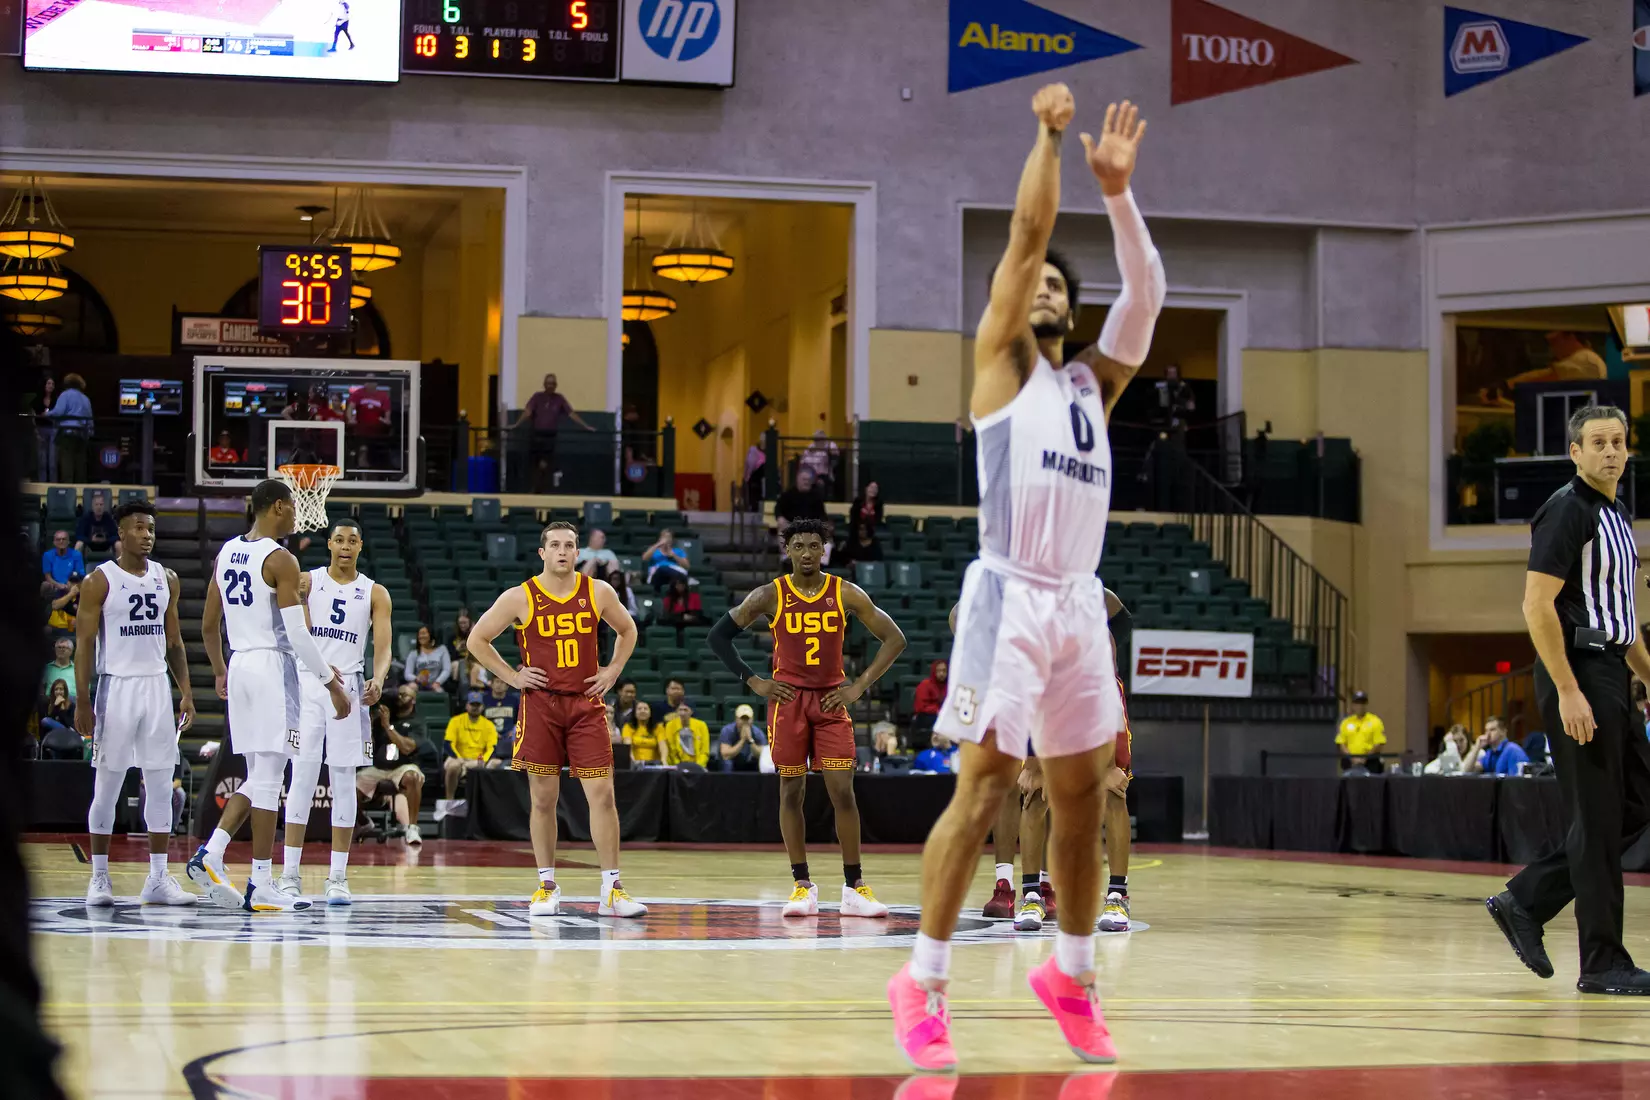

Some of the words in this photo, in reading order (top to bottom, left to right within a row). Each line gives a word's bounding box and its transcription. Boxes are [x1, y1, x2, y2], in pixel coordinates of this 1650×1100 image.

[443, 0, 460, 23] 6
[570, 1, 588, 29] 5
[413, 24, 441, 35] FOULS
[484, 28, 516, 38] PLAYER
[518, 29, 540, 39] FOUL
[581, 32, 609, 42] FOULS
[958, 22, 1075, 54] Alamo
[415, 34, 437, 57] 10
[455, 35, 469, 58] 3
[492, 39, 500, 58] 1
[522, 38, 537, 61] 3
[1182, 33, 1275, 66] TORO
[286, 254, 343, 279] 9:55
[282, 281, 331, 325] 30
[216, 346, 291, 354] EXPERIENCE
[1070, 401, 1095, 452] 0
[230, 552, 250, 565] CAIN
[224, 569, 253, 606] 23
[535, 594, 543, 602] C
[786, 593, 792, 602] C
[129, 593, 159, 621] 25
[330, 598, 346, 625] 5
[310, 626, 358, 644] MARQUETTE
[536, 611, 592, 637] USC
[785, 611, 838, 634] USC
[556, 639, 579, 668] 10
[805, 637, 820, 665] 2
[1136, 647, 1248, 679] ESPN
